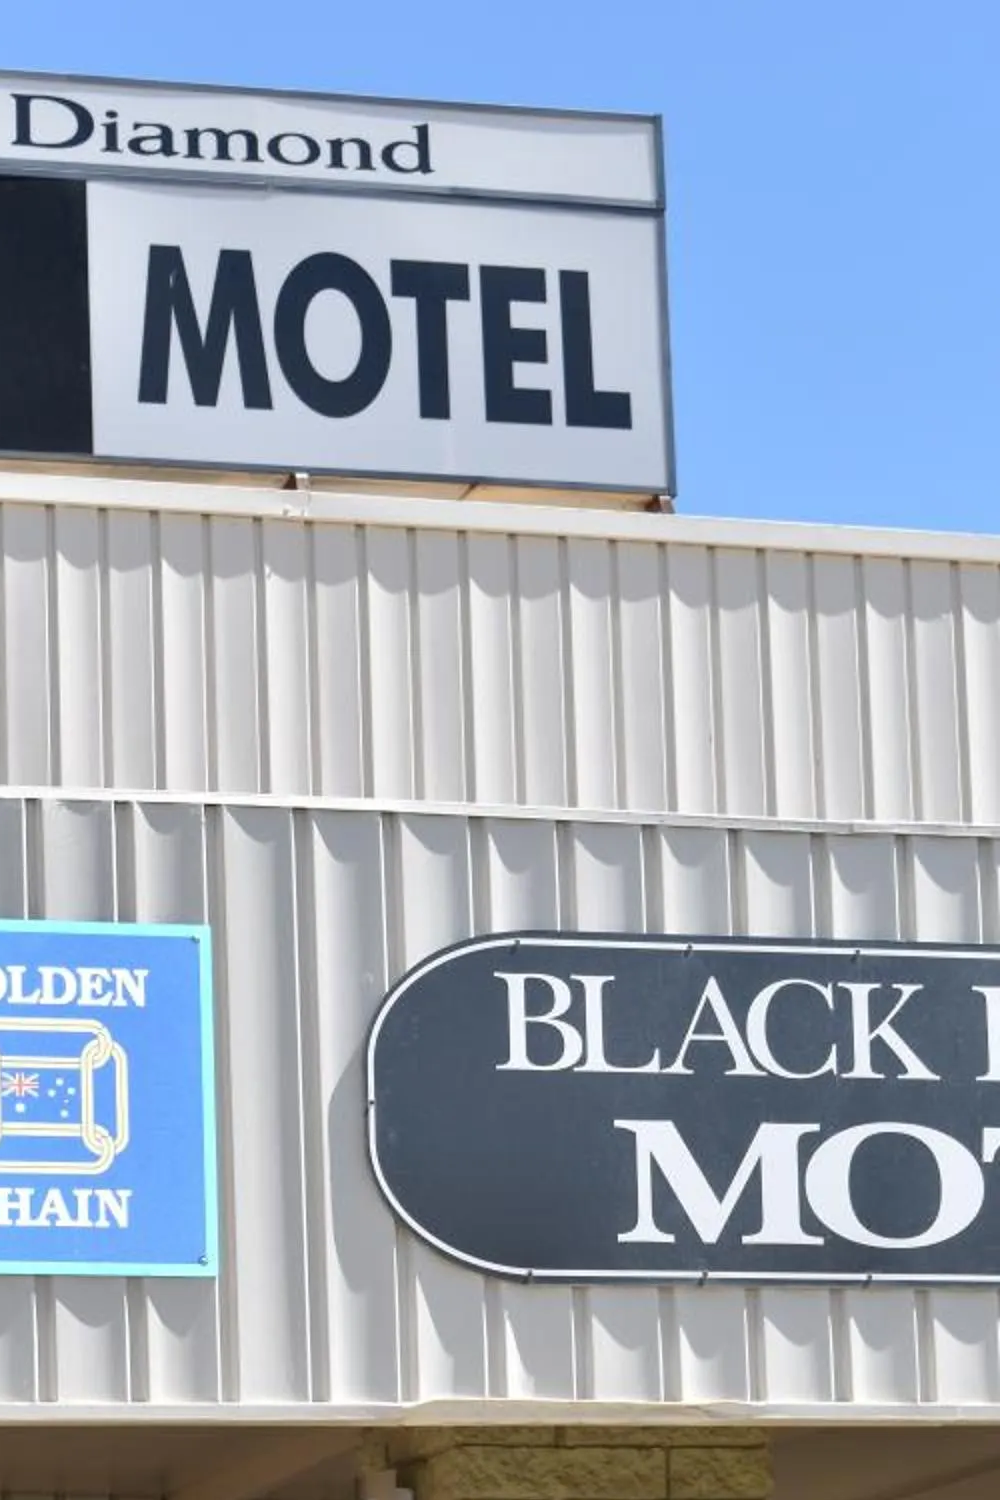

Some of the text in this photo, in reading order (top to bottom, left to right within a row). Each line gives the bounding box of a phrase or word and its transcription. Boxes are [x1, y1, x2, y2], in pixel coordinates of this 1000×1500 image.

[10, 92, 435, 176] Diamond
[138, 245, 632, 430] MOTEL
[494, 971, 941, 1081] BLACK
